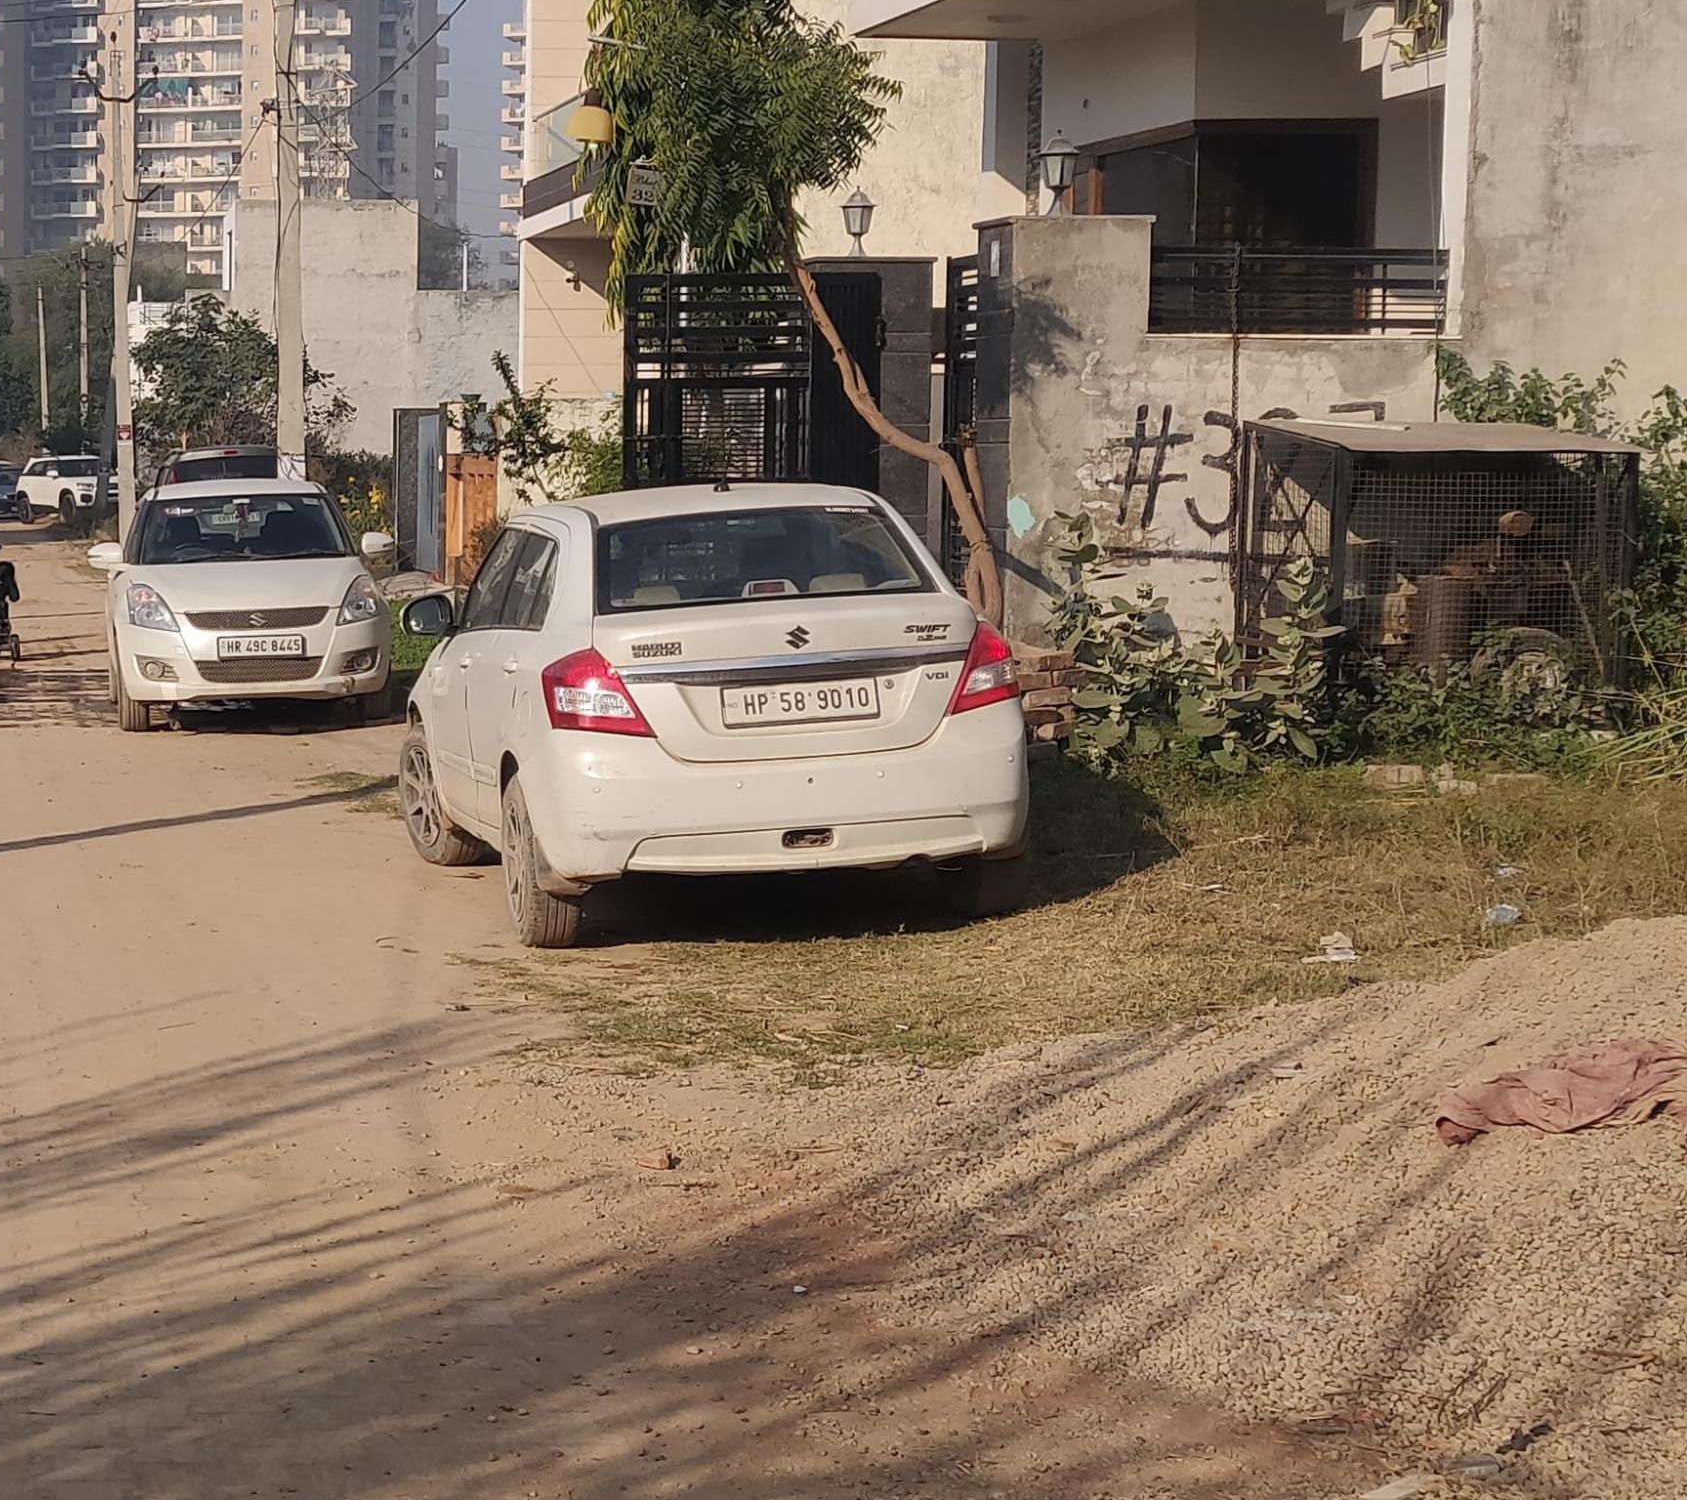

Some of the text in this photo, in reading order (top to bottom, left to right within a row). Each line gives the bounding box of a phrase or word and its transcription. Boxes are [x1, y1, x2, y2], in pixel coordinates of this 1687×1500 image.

[903, 623, 951, 634] SWIFT
[227, 641, 241, 653] HR
[246, 640, 267, 652] 49C
[272, 639, 300, 651] 8445
[631, 649, 682, 659] SUZUKI
[743, 687, 869, 715] HP 58 9010
